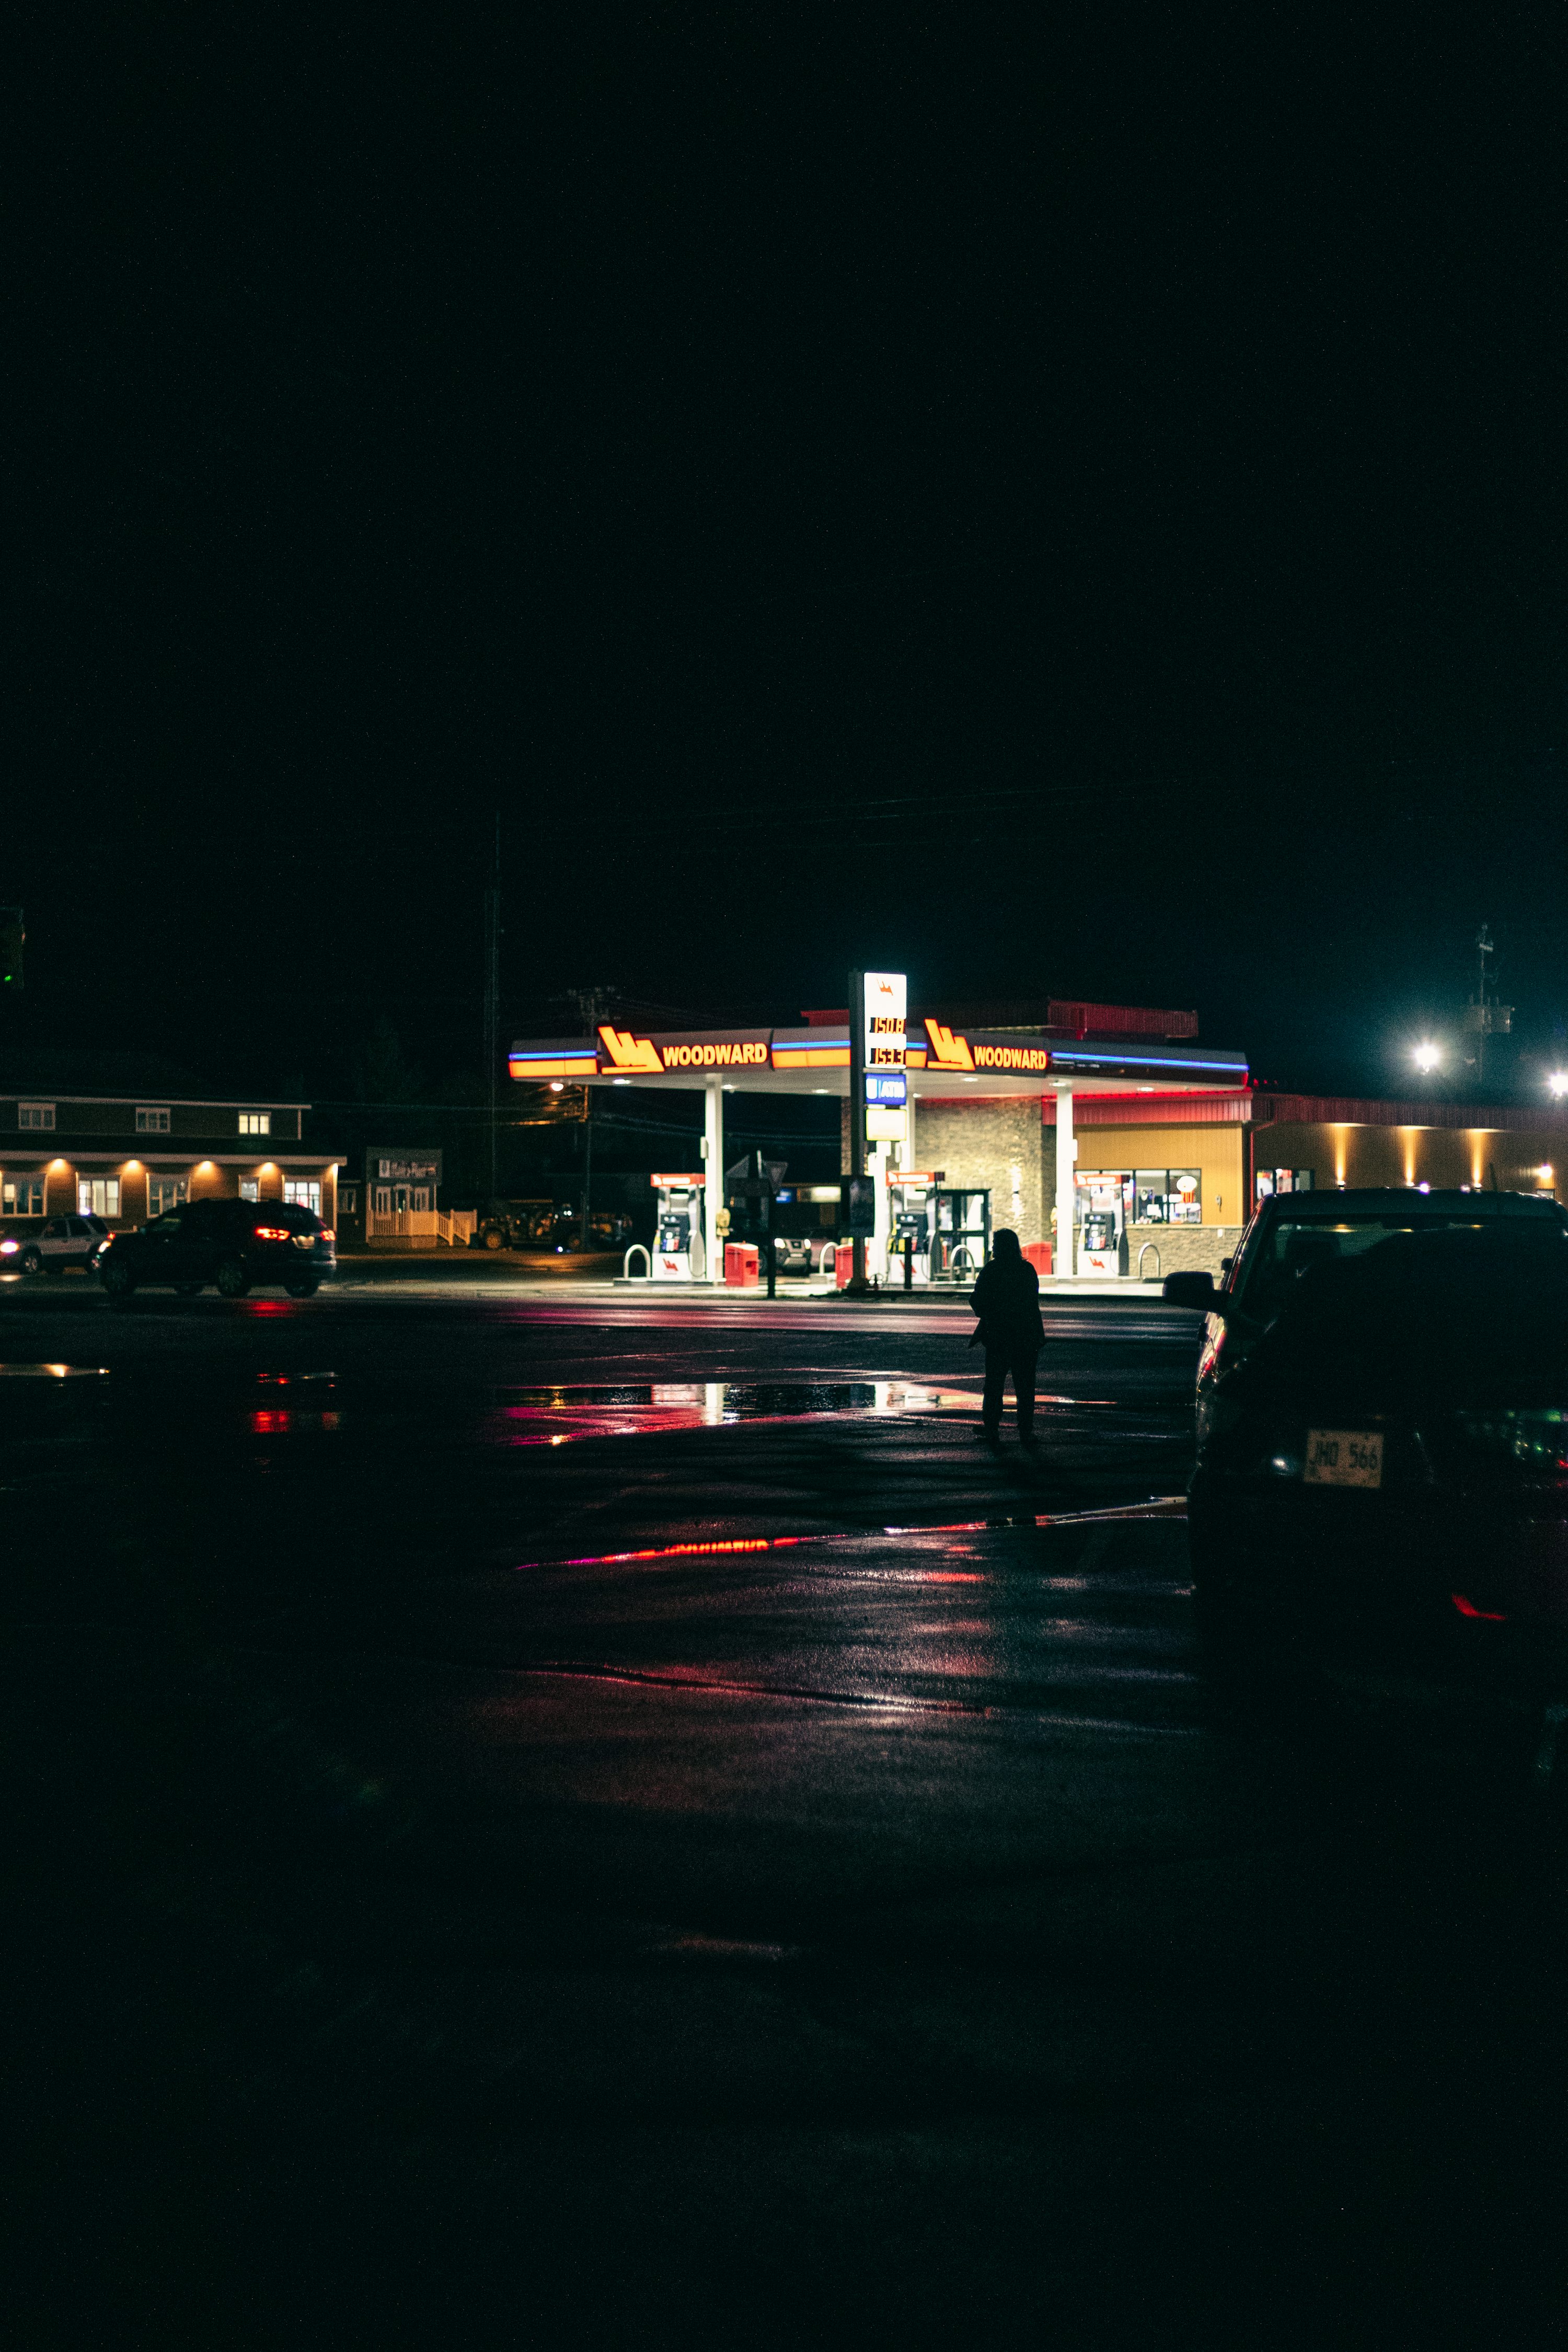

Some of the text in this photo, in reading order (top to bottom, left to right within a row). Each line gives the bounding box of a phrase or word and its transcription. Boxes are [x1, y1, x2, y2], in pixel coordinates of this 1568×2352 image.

[663, 1043, 767, 1067] WOODWARD
[974, 1046, 1047, 1070] WOODWARD
[881, 1081, 905, 1098] ATM
[1348, 1443, 1378, 1470] 566
